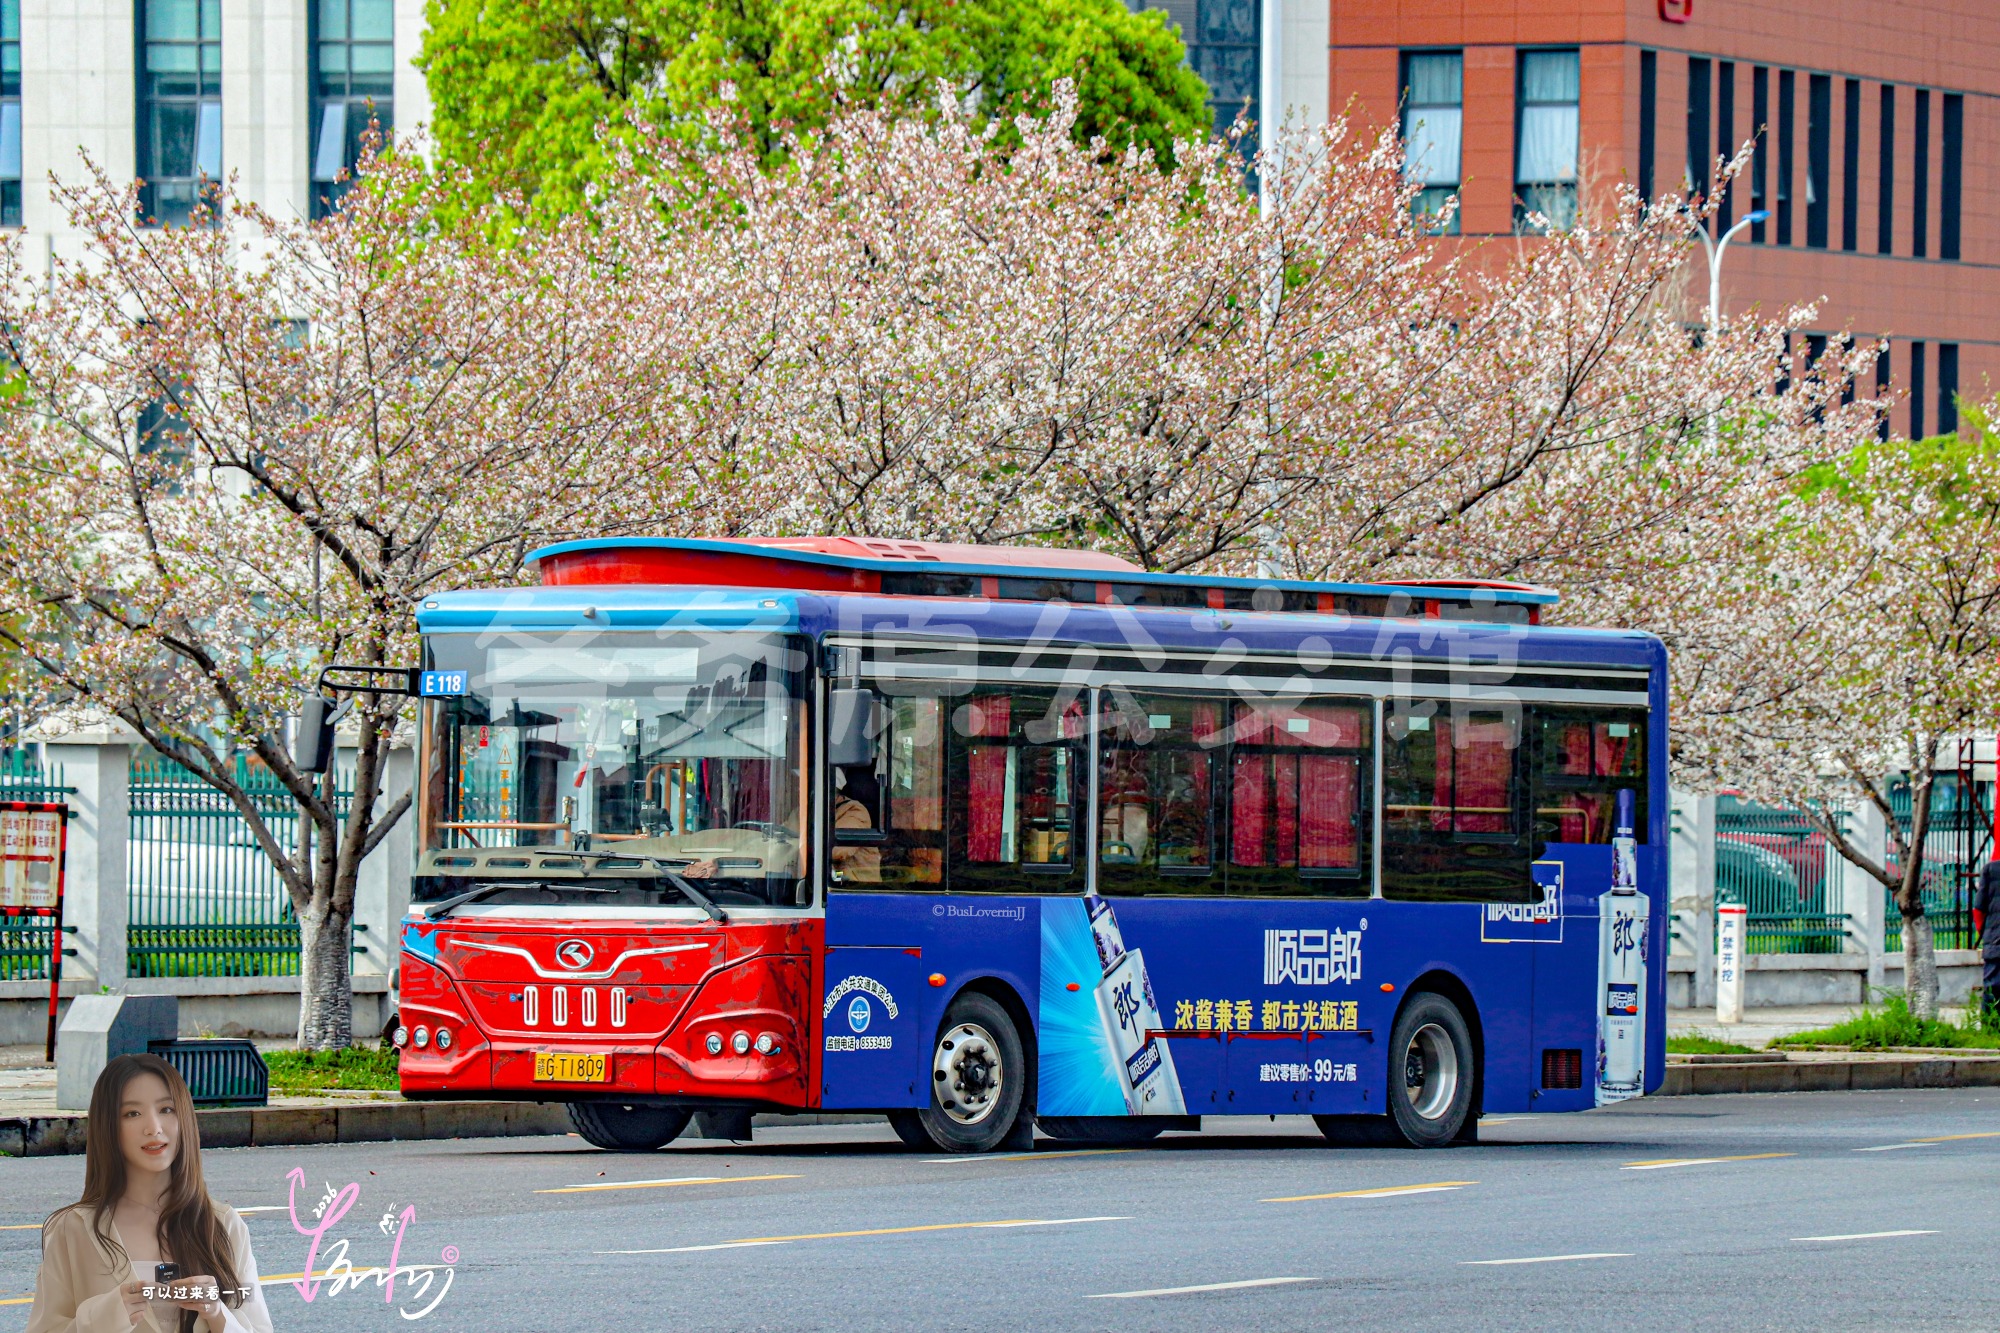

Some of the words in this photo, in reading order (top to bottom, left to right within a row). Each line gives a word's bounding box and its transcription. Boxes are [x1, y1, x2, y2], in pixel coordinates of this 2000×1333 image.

[426, 675, 434, 693] E
[438, 675, 461, 693] 118
[1264, 927, 1361, 985] 顺品郎
[1613, 910, 1635, 979] 郎
[1722, 920, 1734, 982] 严禁开挖
[823, 975, 899, 1020] 九江市公共交通集团公司
[1113, 980, 1140, 1043] 郎
[1174, 999, 1253, 1031] 浓酱兼香
[1261, 999, 1358, 1031] 都市光瓶酒
[1129, 1042, 1159, 1083] 顺品郎
